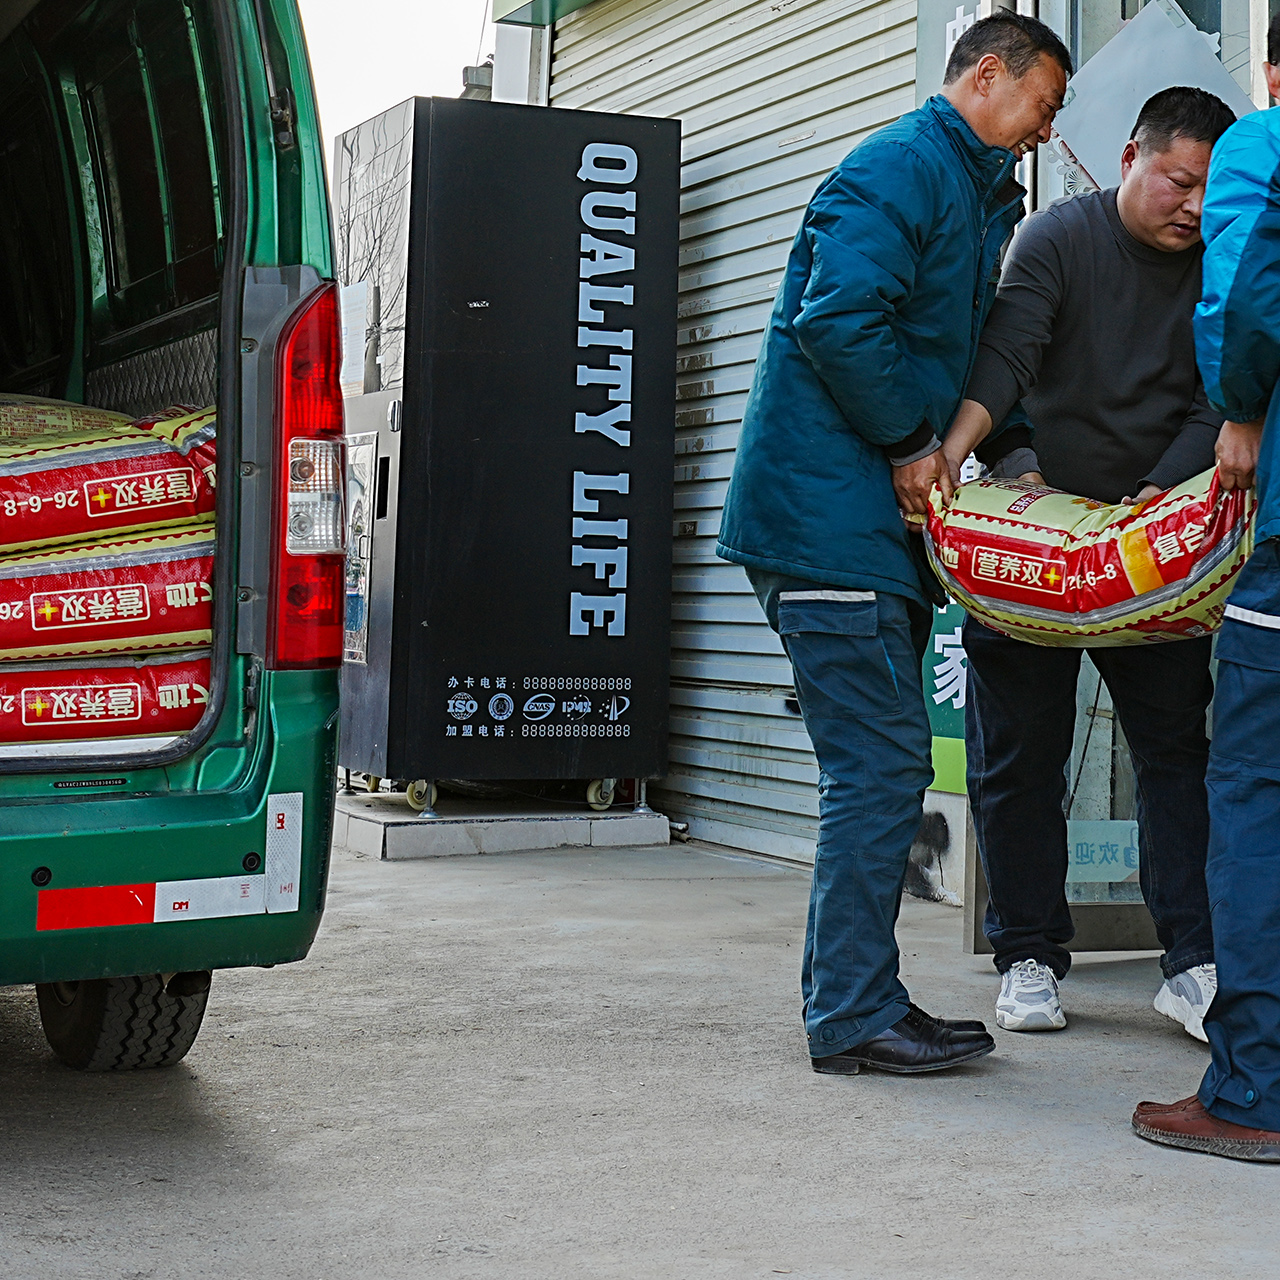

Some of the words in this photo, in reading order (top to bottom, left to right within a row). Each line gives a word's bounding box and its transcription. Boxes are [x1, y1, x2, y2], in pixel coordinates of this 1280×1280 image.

[575, 141, 638, 448] QUALITY
[3, 489, 80, 518] 26-6-8
[569, 470, 631, 638] LIFE
[447, 699, 479, 714] ISO
[527, 702, 552, 711] CNAS
[276, 812, 286, 830] DM
[172, 900, 190, 911] DM
